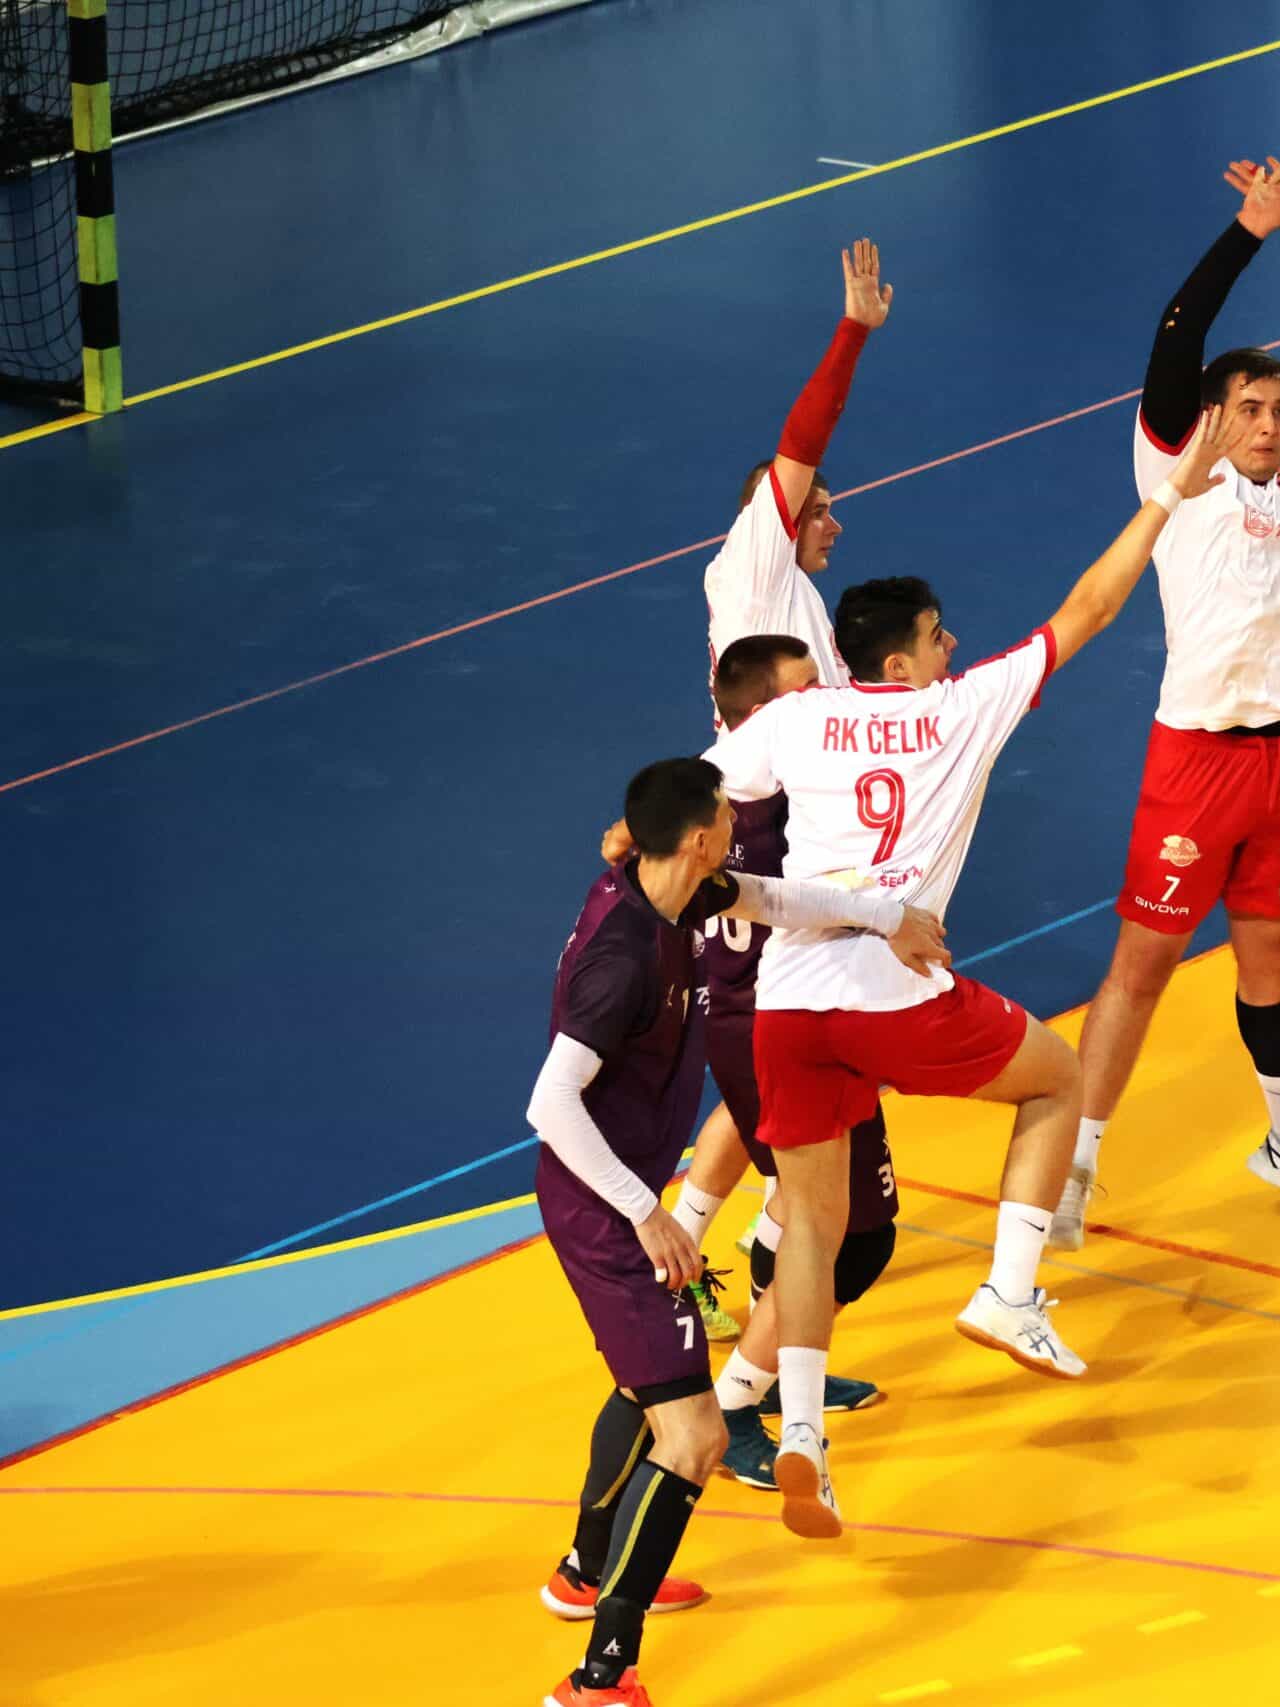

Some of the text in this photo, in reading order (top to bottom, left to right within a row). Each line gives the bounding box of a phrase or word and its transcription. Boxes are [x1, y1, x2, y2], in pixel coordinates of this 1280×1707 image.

[823, 713, 944, 754] RK ČELIK
[855, 768, 905, 866] 9
[1135, 895, 1190, 916] GIVOVA
[1161, 874, 1181, 902] 7
[676, 1315, 694, 1350] 7
